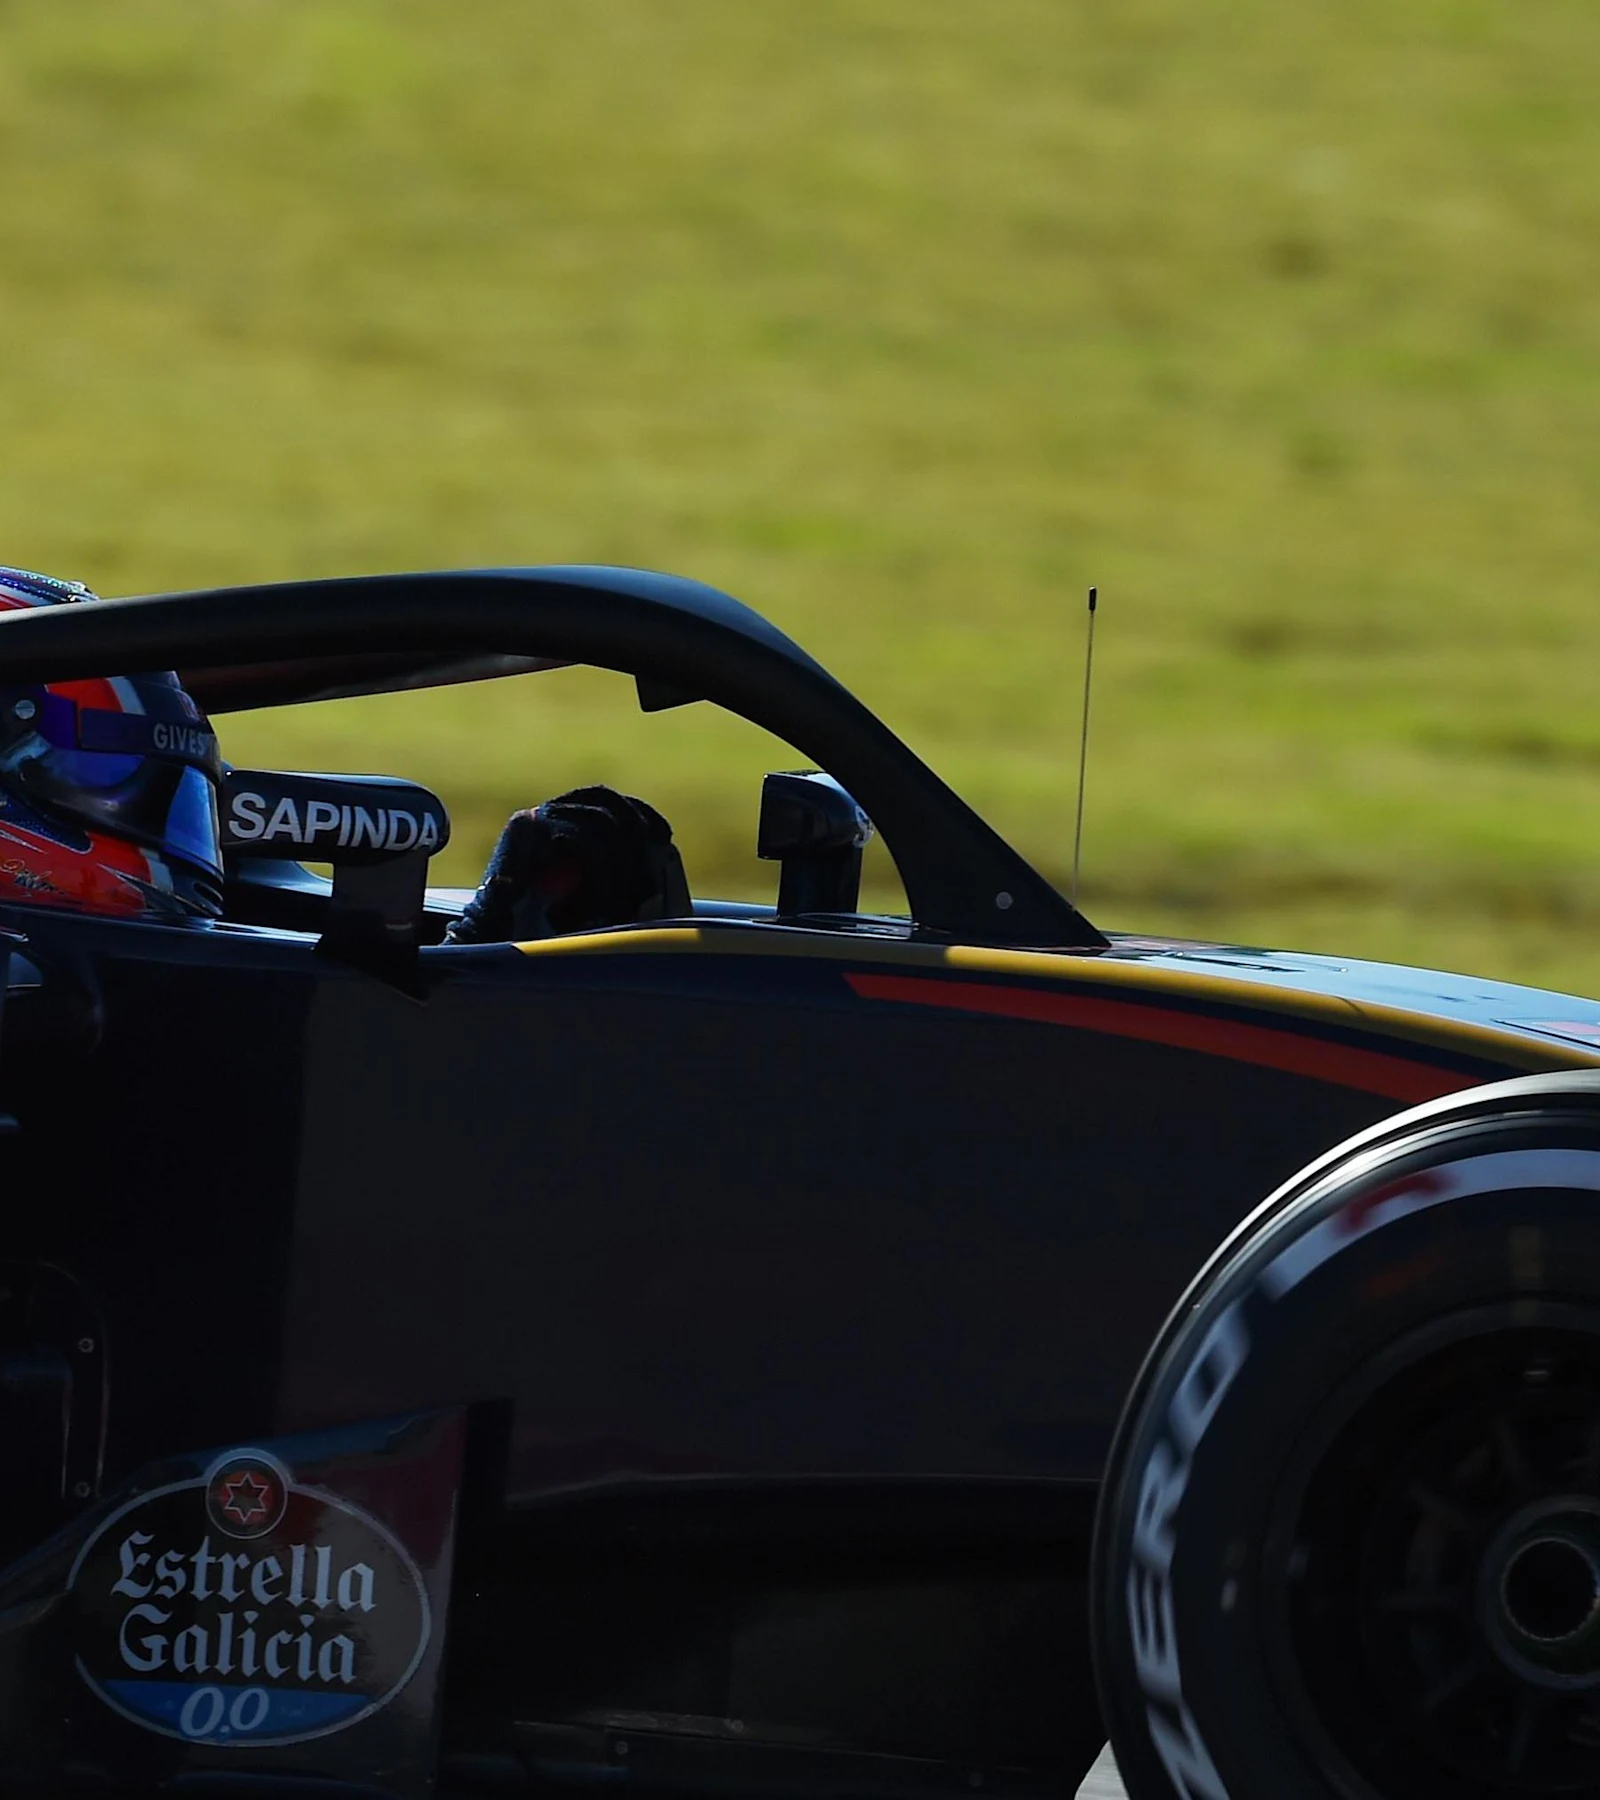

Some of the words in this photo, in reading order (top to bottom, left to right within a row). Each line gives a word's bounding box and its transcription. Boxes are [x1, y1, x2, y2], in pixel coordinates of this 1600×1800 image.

[228, 792, 439, 851] SAPINDA
[110, 1530, 376, 1612] Estrella
[118, 1603, 357, 1684] Galicia
[179, 1687, 270, 1737] 0.0
